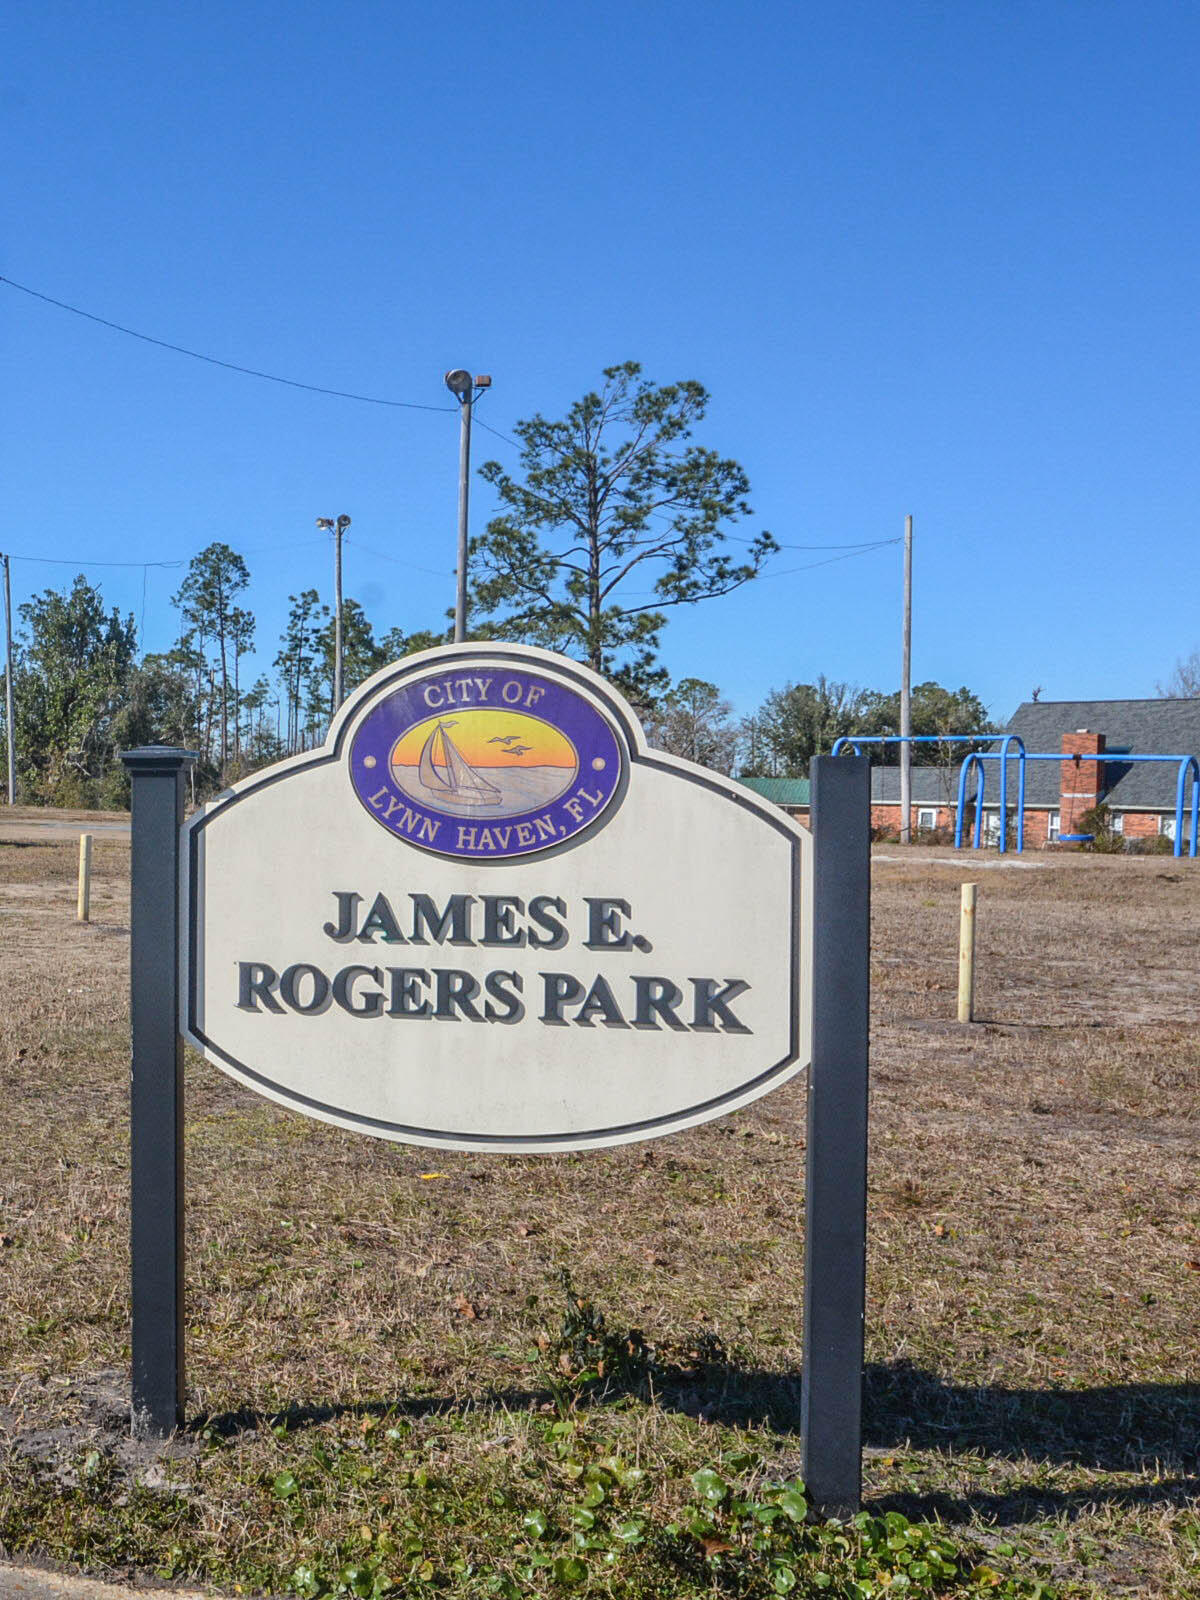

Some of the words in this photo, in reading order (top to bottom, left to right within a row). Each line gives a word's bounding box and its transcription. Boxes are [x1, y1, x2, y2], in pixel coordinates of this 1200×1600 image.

[424, 678, 493, 708] CITY
[502, 680, 545, 708] OF
[368, 786, 442, 842] LYNN
[456, 814, 567, 850] HAVEN,
[563, 787, 604, 823] FL
[323, 891, 570, 950] JAMES
[582, 897, 653, 953] E.
[234, 961, 525, 1024] ROGERS
[538, 973, 754, 1034] PARK
